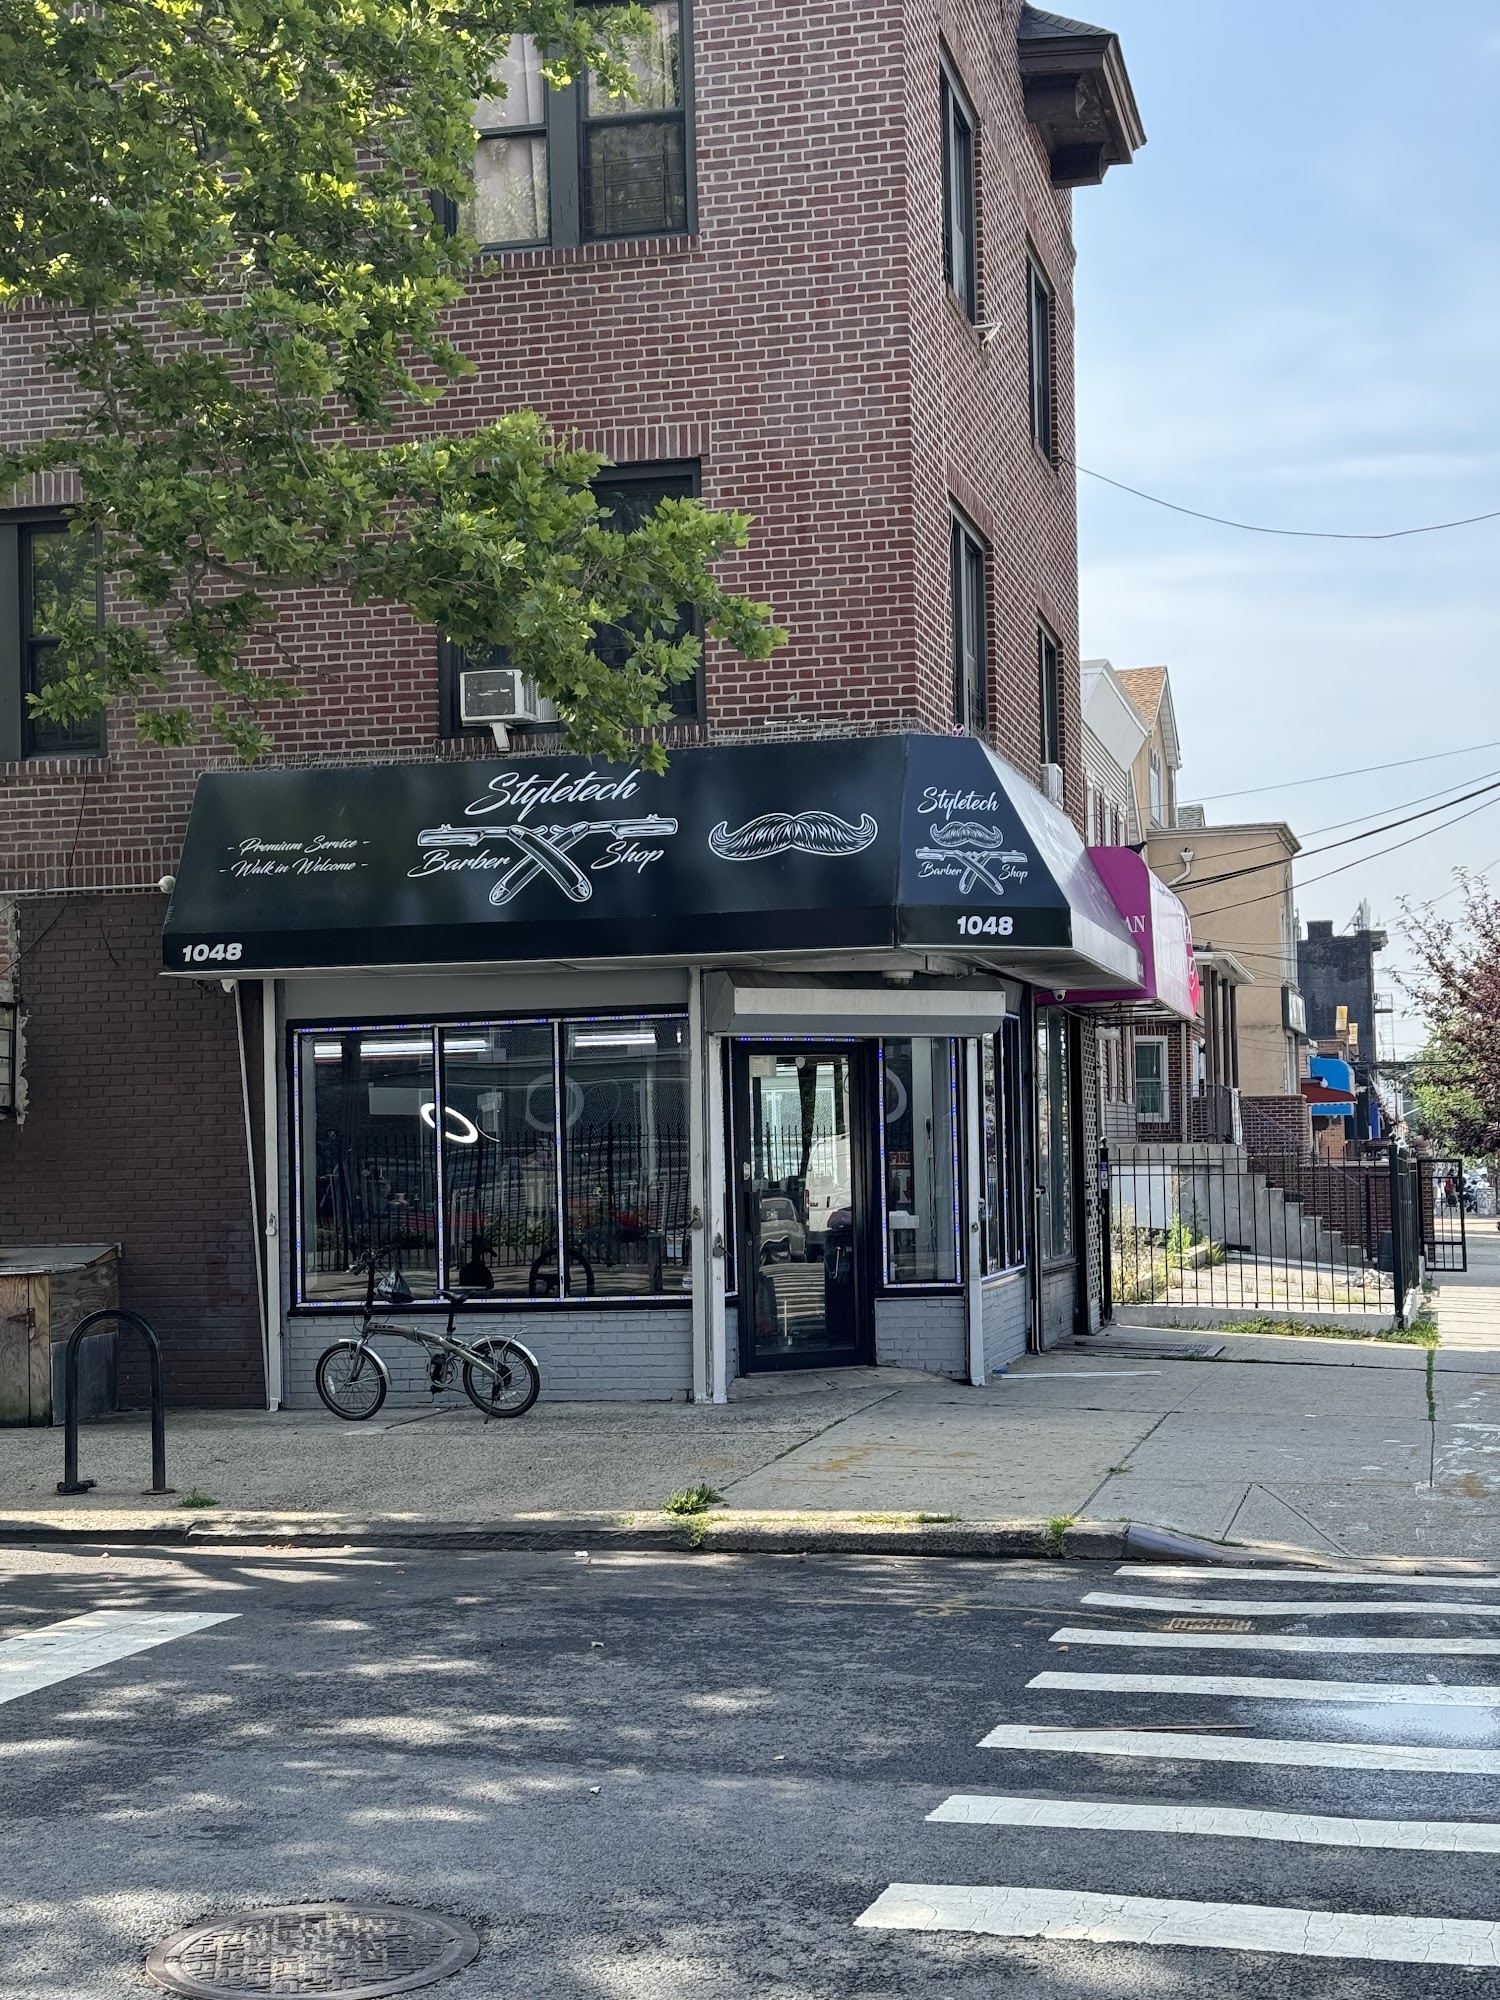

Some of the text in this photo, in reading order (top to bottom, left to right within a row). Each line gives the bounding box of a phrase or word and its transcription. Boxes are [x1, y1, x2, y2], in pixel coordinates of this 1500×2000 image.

[464, 769, 641, 822] Styletech
[917, 786, 1000, 820] Styletech
[239, 835, 358, 856] Premium Service
[292, 856, 357, 875] Welcome
[407, 841, 665, 878] Barber Shop
[918, 861, 1028, 884] Barber Shop
[957, 915, 1014, 936] 1048
[182, 942, 243, 962] 1048
